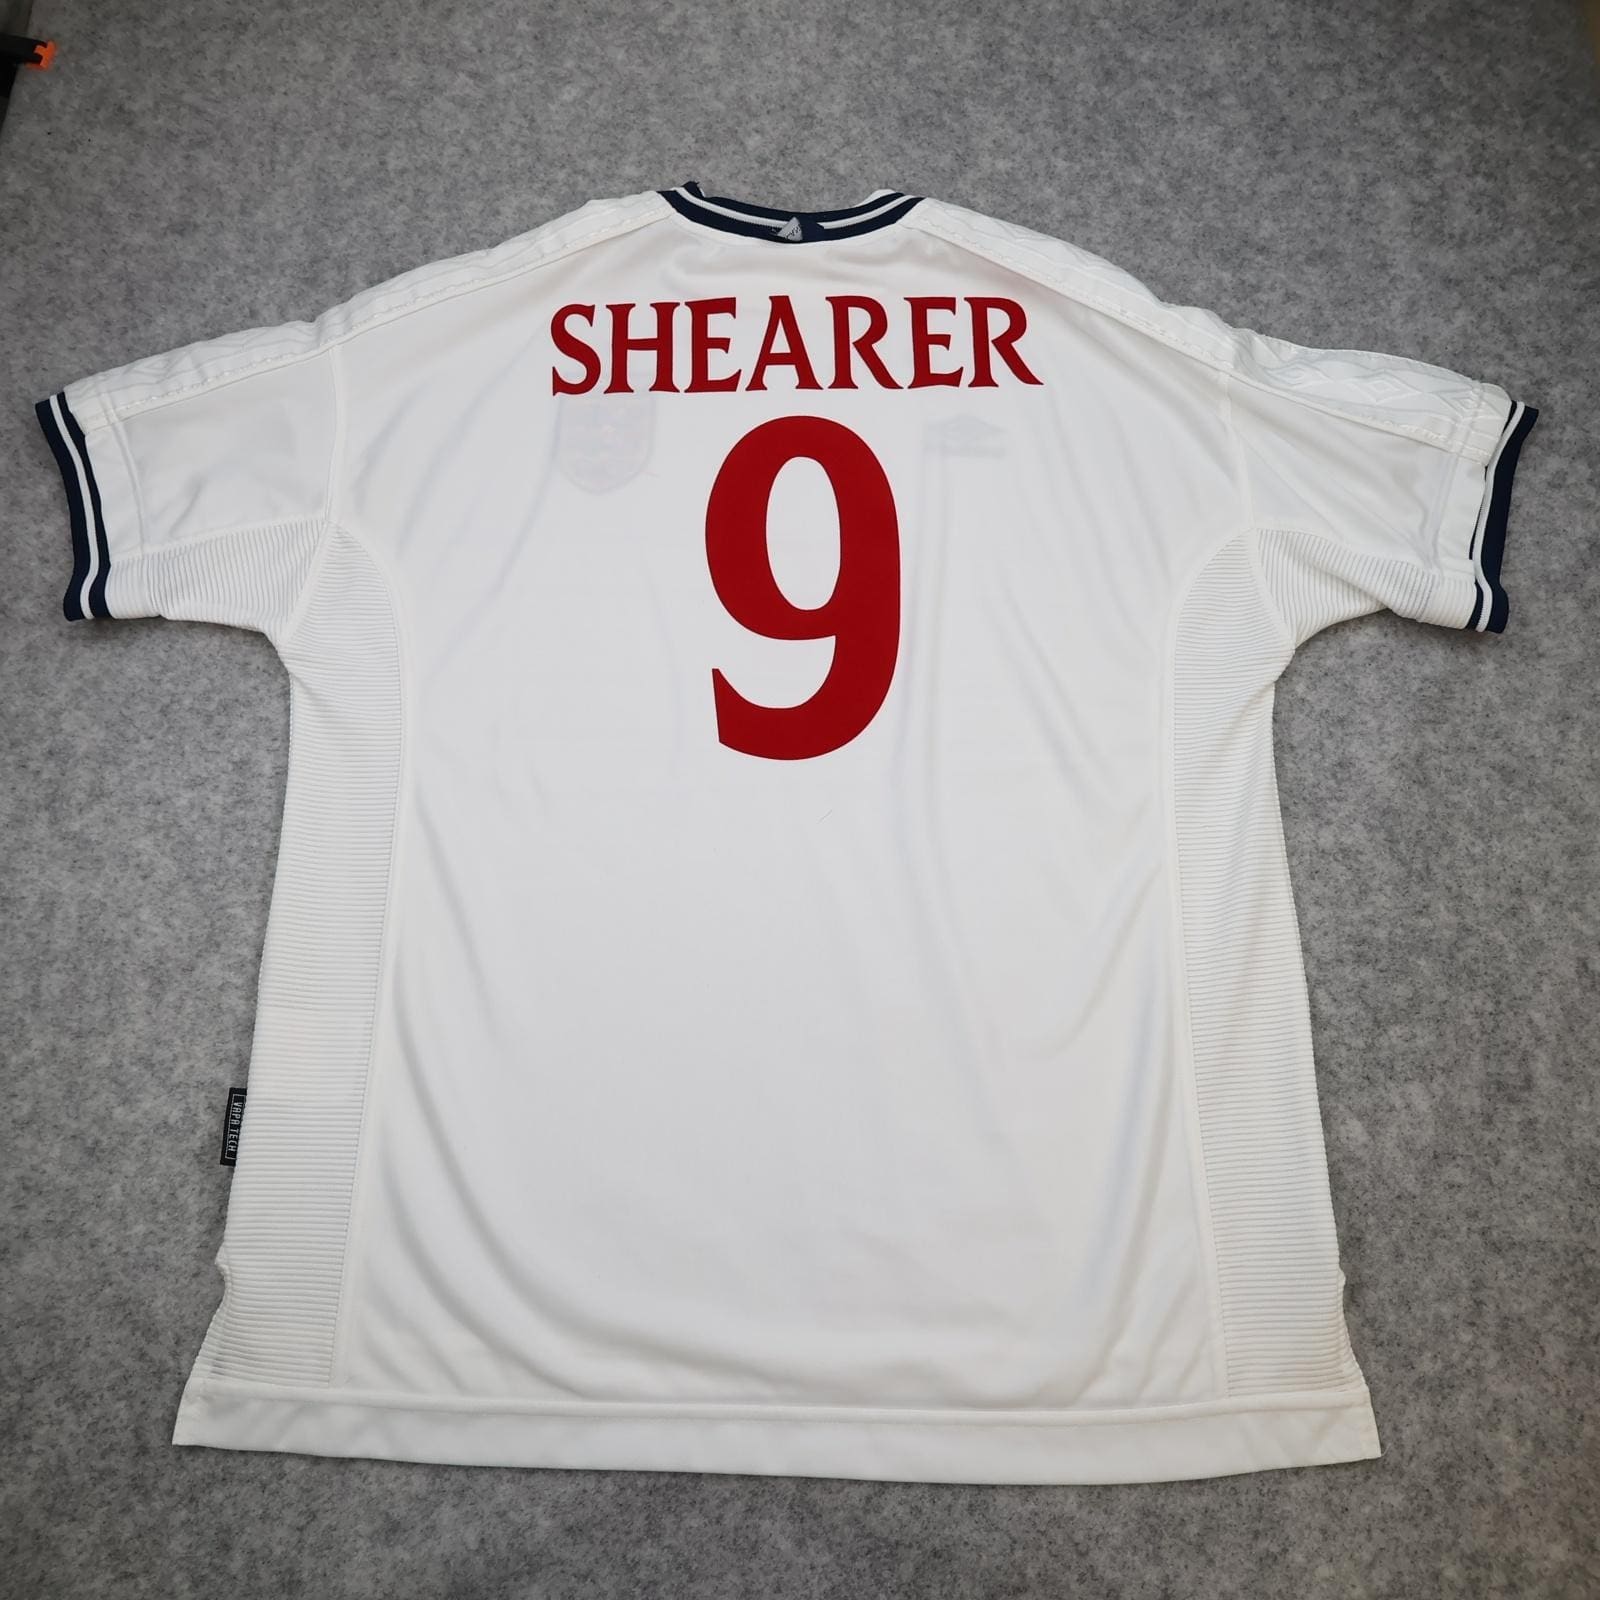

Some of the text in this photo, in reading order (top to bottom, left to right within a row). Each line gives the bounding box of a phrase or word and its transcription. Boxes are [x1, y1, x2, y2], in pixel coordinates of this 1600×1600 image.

[551, 295, 1044, 396] SHEARER
[705, 415, 902, 761] 9
[228, 1102, 242, 1152] VAPA TECH
